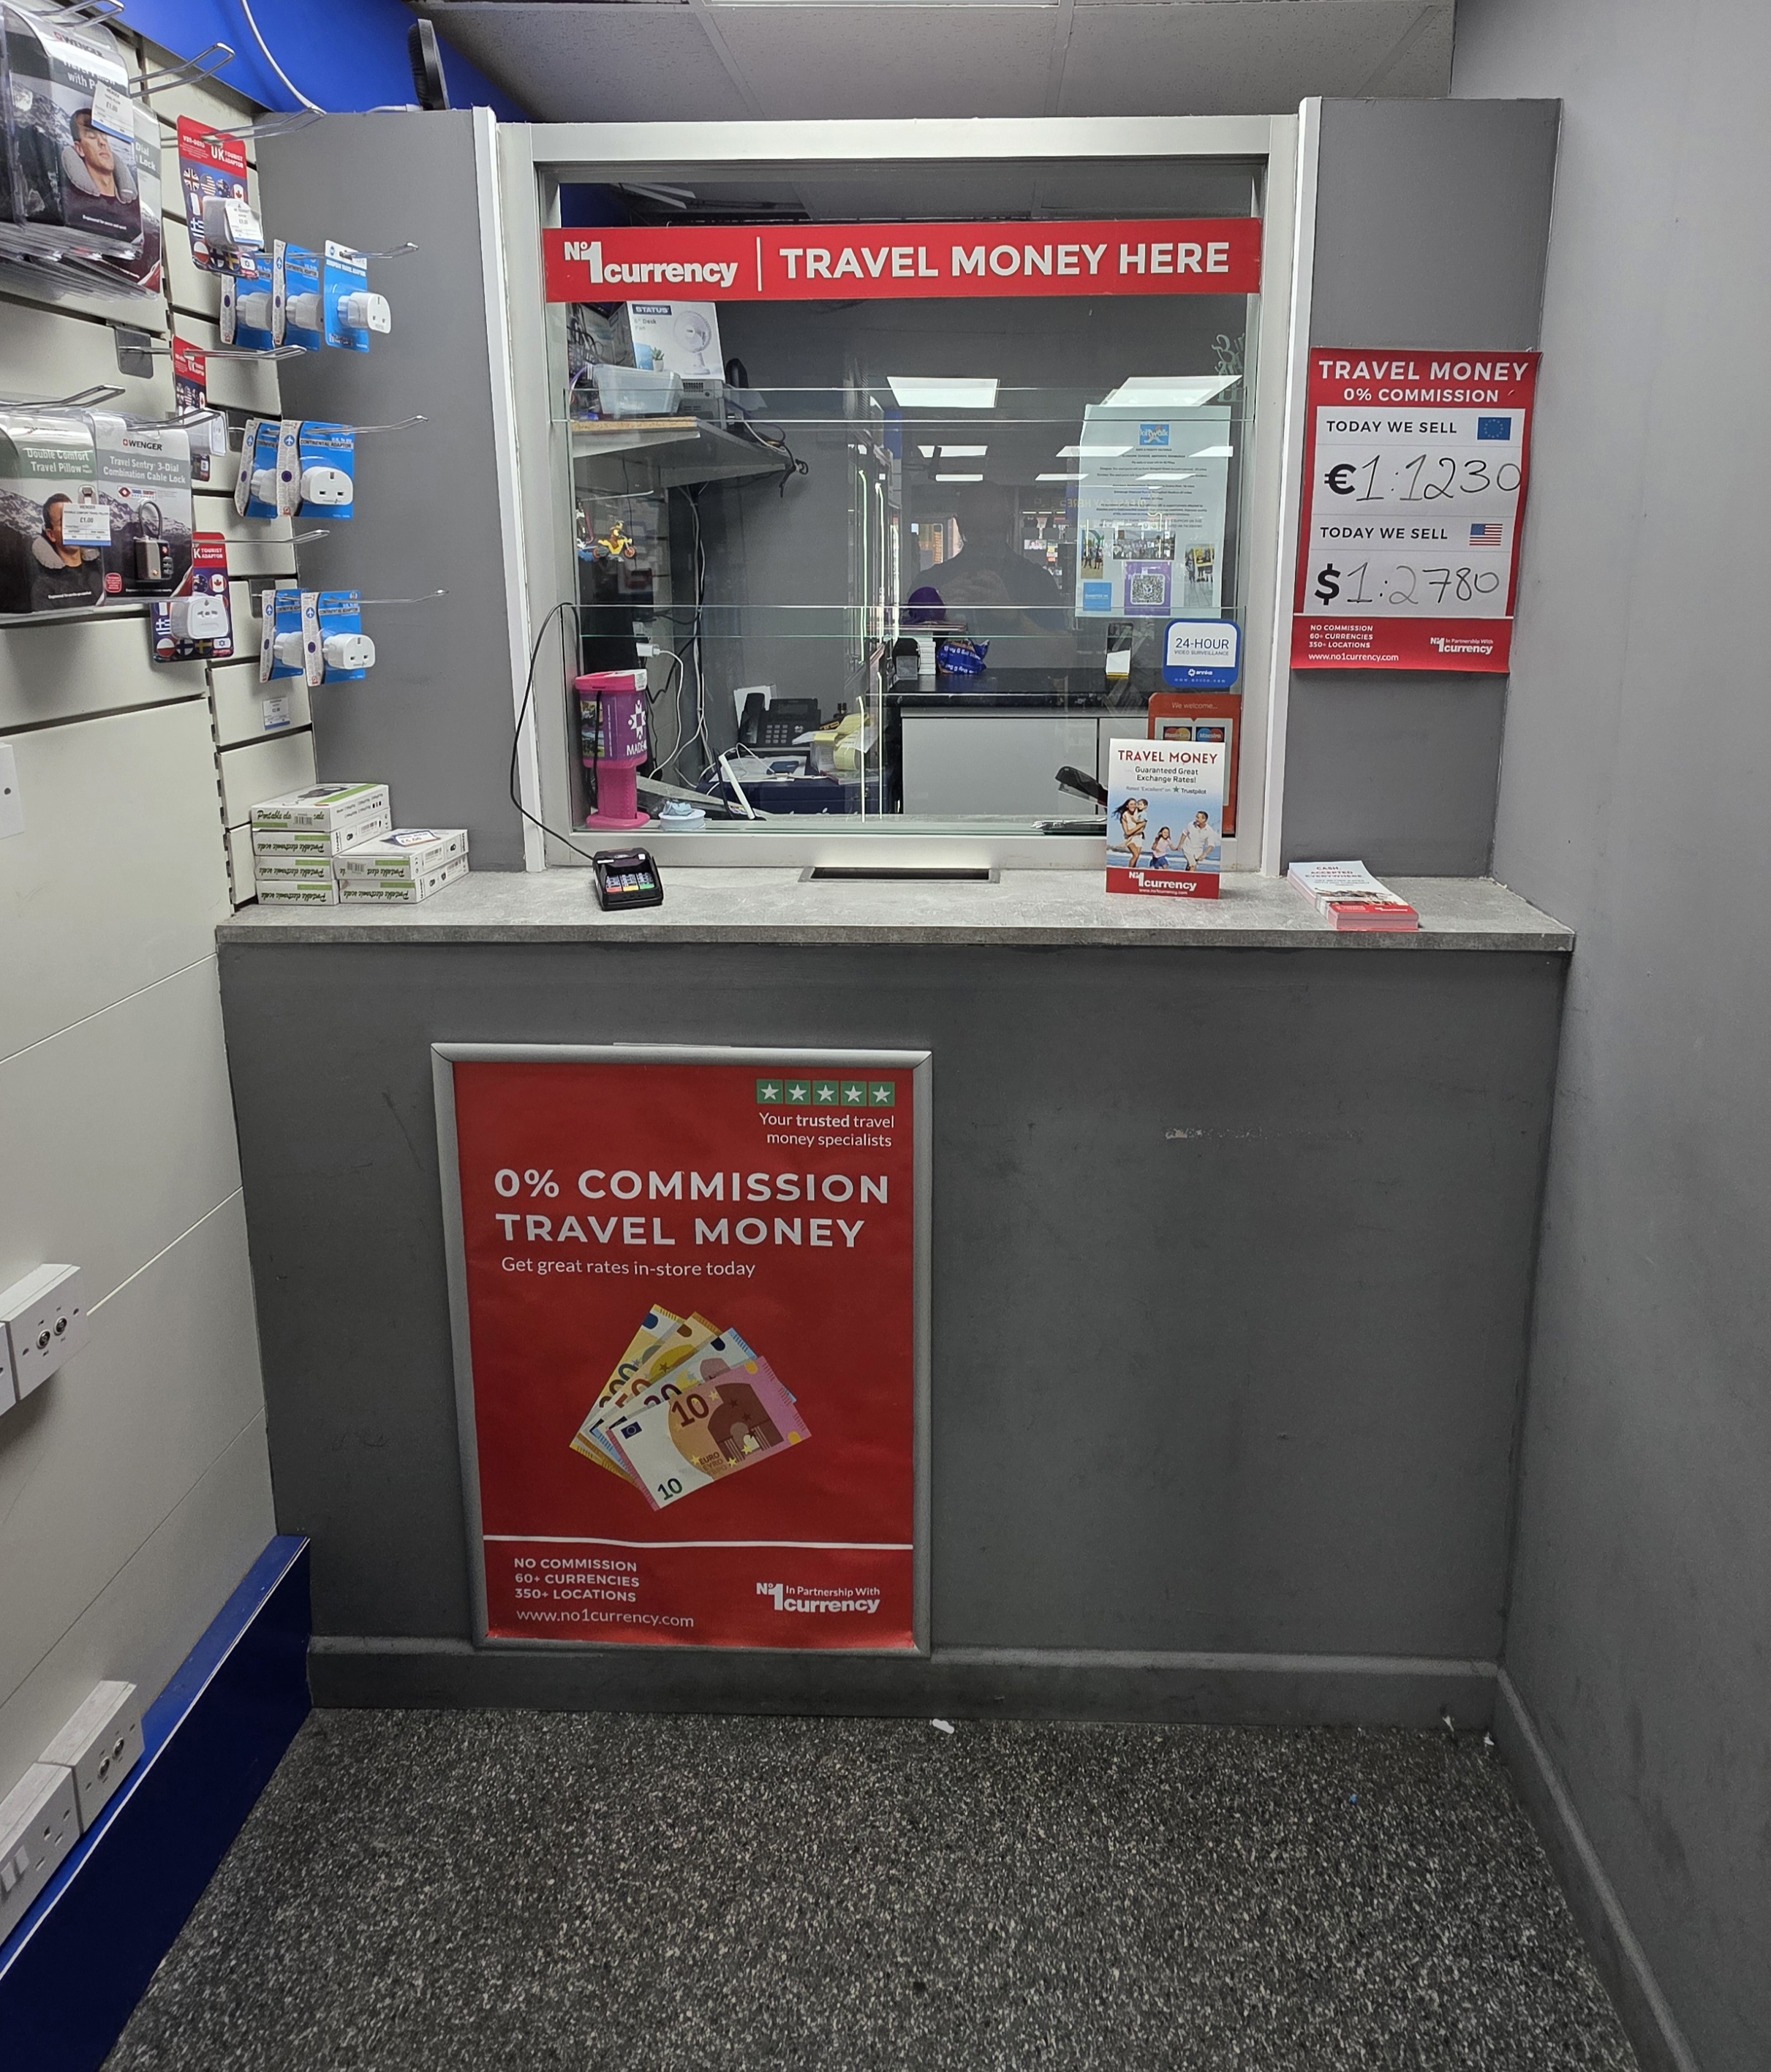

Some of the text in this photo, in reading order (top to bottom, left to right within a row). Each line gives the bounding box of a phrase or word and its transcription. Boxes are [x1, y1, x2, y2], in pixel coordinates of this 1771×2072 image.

[211, 145, 225, 162] UK
[224, 150, 243, 162] TOURIST
[139, 156, 157, 171] Lock
[779, 242, 1230, 279] TRAVEL MONEY HERE
[604, 261, 738, 287] currency
[1319, 360, 1528, 381] TRAVEL MONEY
[1344, 388, 1499, 402] 0% COMMISSION
[1326, 420, 1457, 434] TODAY WE SELL
[129, 440, 162, 451] WENGER
[27, 448, 89, 461] Double Comfort
[31, 461, 81, 473] Travel Pillow
[110, 456, 179, 472] Travel Sentry 3-Dial
[103, 466, 186, 484] Combination Cable Lock
[1320, 527, 1449, 540] TODAY WE SELL
[193, 548, 201, 559] K
[1176, 638, 1229, 649] 24-HOUR
[1444, 645, 1493, 655] currency
[1308, 653, 1399, 662] www.no1currency.com
[1118, 750, 1218, 764] TRAVEL MONEY
[1135, 766, 1177, 774] Guaranteed
[1137, 775, 1171, 783] Exchange
[257, 810, 282, 820] Portable
[258, 843, 324, 853] Portable electronic scale
[259, 867, 324, 878] Portable electronic scale
[380, 868, 405, 877] Portable
[1144, 879, 1197, 891] currency
[261, 892, 326, 902] Portable electronic scale
[344, 890, 409, 899] Portable electronic scale
[759, 1112, 894, 1128] Your trusted travel
[767, 1133, 892, 1148] money specialists
[494, 1168, 889, 1204] 0% COMMISSION
[495, 1213, 864, 1248] TRAVEL MONEY
[502, 1257, 756, 1279] Get great rates in-store today
[671, 1393, 709, 1428] 10
[698, 1452, 720, 1465] EURO
[657, 1478, 683, 1501] 10
[514, 1558, 637, 1572] NO COMMISSION
[515, 1574, 640, 1588] 60+ CURRENCIES
[515, 1589, 636, 1603] 350+ LOCATIONS
[786, 1585, 880, 1598] In Partnership With
[784, 1598, 880, 1614] currency
[516, 1608, 694, 1629] www.no1currency.com
